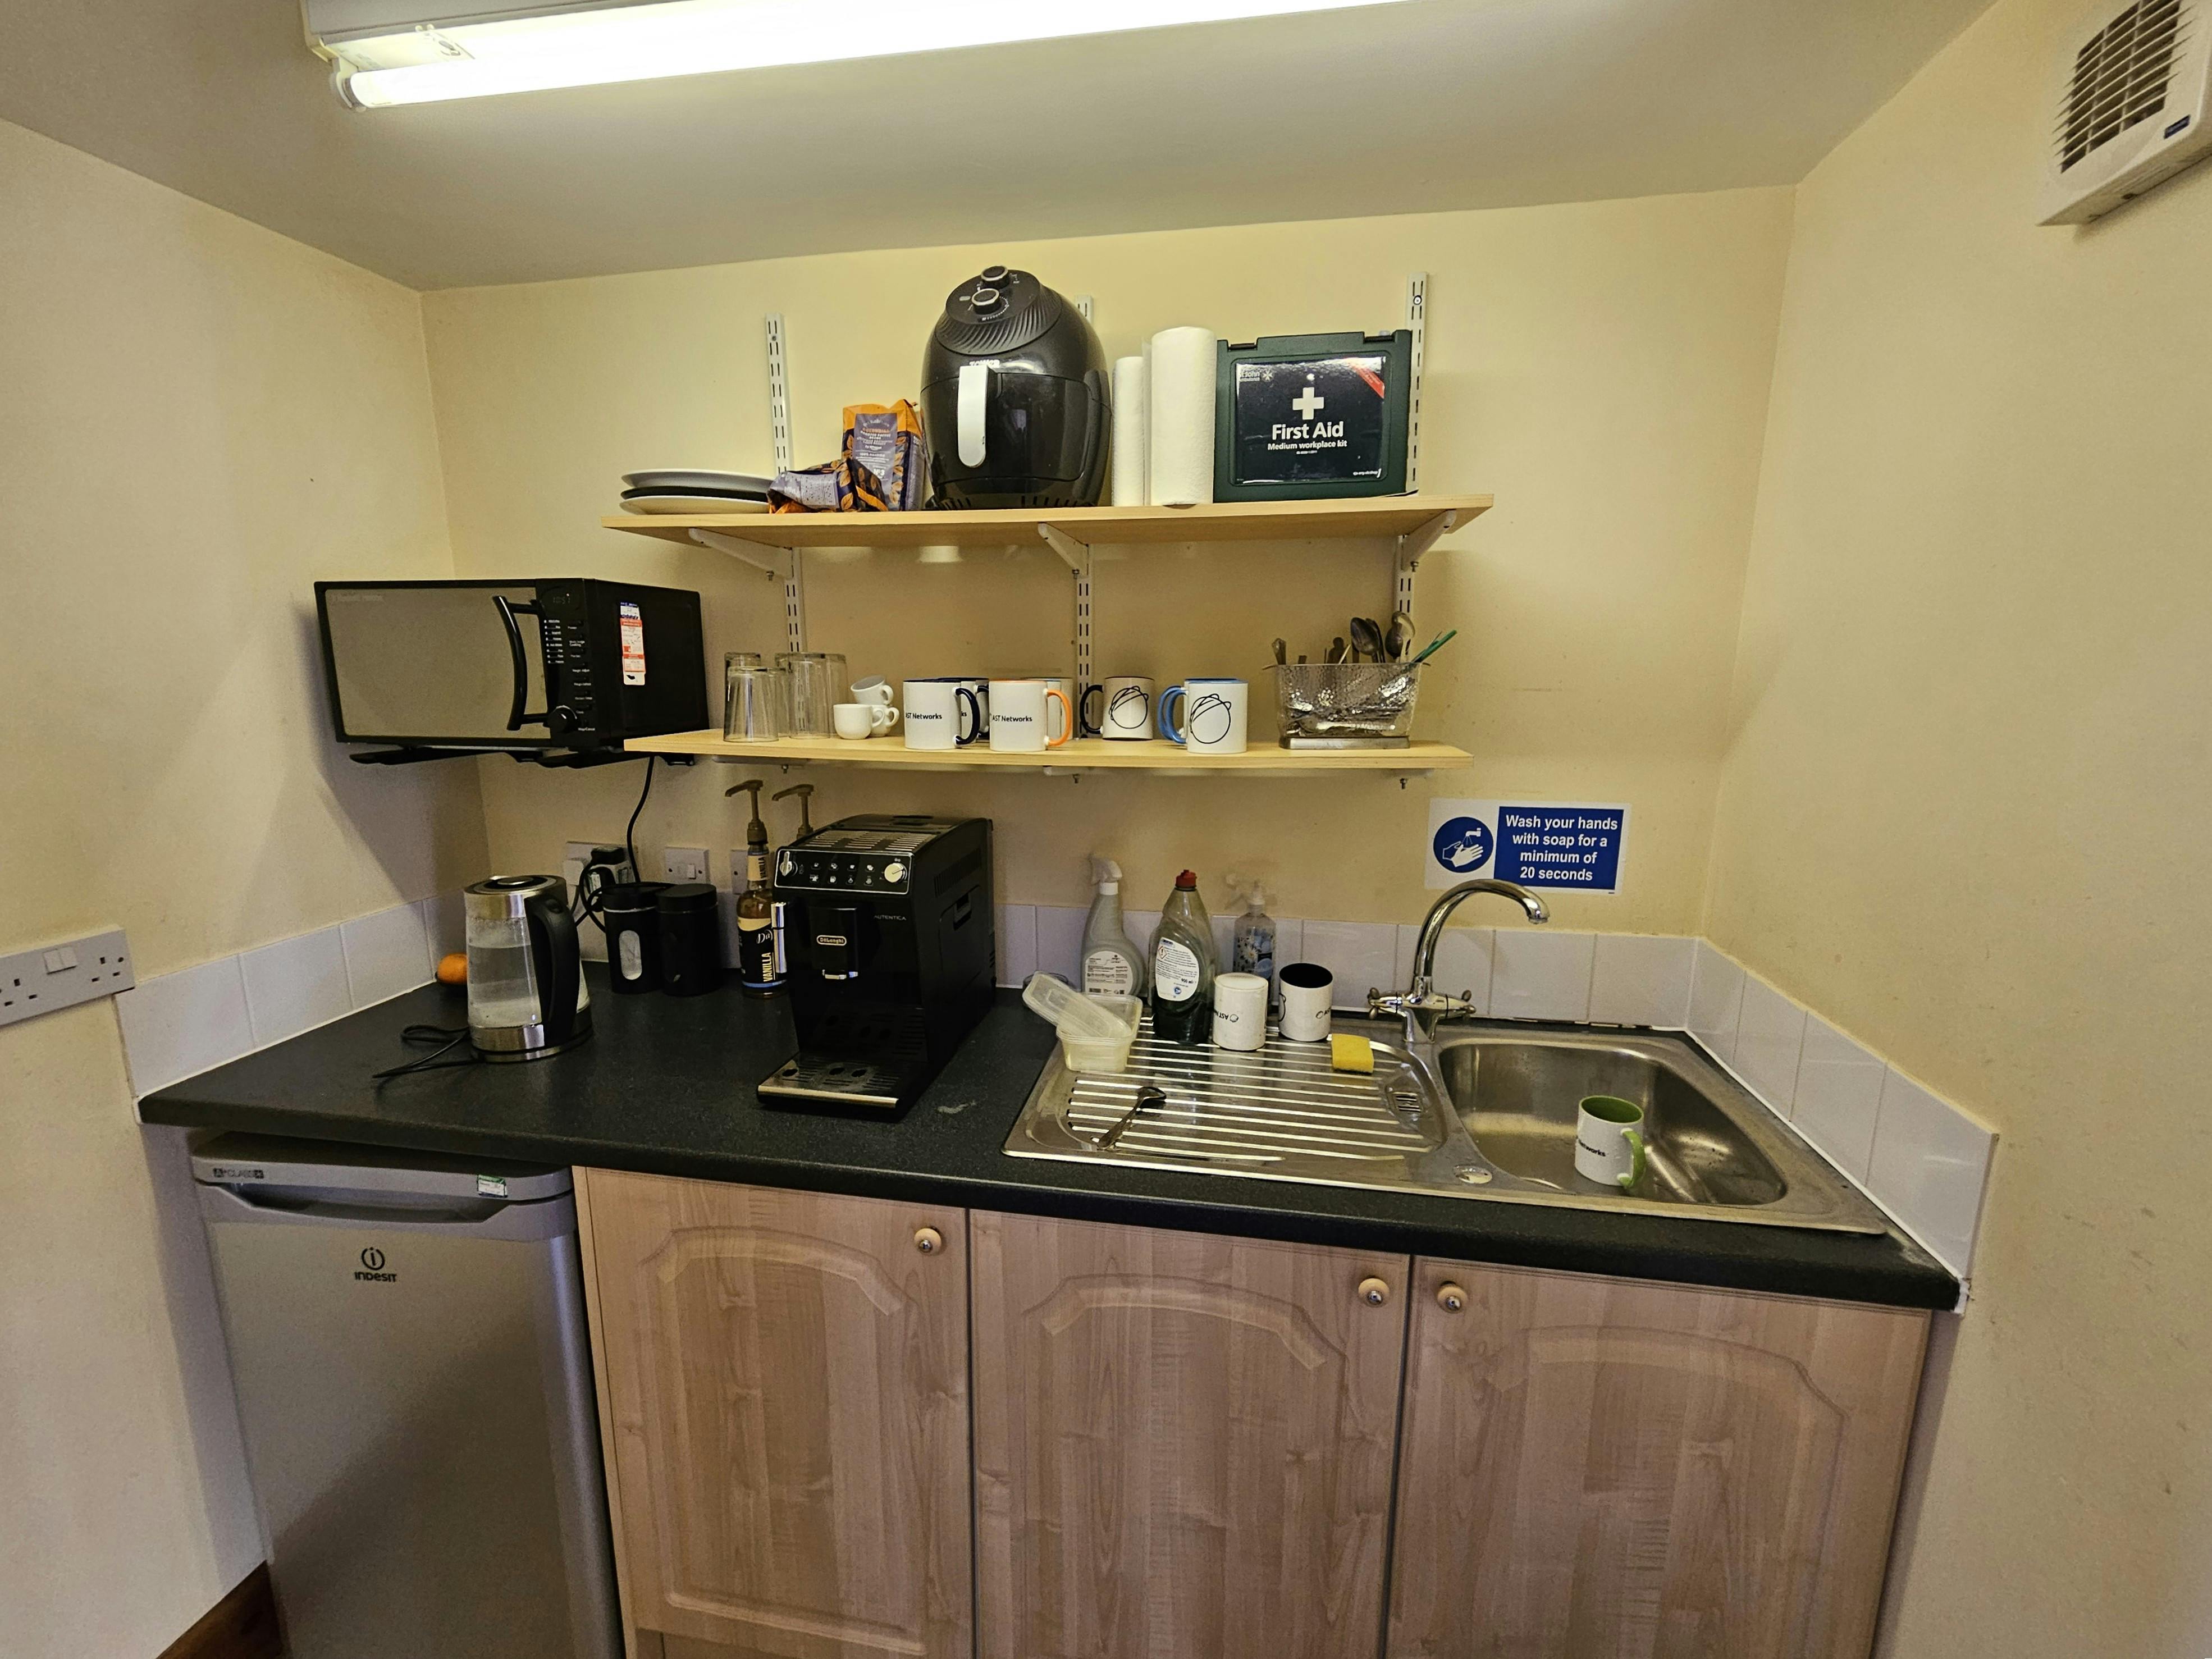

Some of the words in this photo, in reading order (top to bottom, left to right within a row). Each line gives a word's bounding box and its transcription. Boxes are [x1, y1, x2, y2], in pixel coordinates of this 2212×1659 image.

[1272, 423, 1309, 440] First
[1313, 421, 1343, 438] Aid
[1299, 441, 1336, 450] workplace
[1506, 815, 1541, 828] Wash
[1544, 819, 1574, 831] your
[1578, 816, 1618, 830] hands
[1512, 833, 1539, 845] with
[1543, 835, 1574, 849] soap
[1578, 834, 1597, 847] for
[1599, 837, 1607, 847] a
[1520, 849, 1580, 863] minimum
[1583, 851, 1598, 863] of
[1520, 866, 1535, 879] 20
[1538, 868, 1593, 881] seconds
[761, 952, 773, 982] VANILLA
